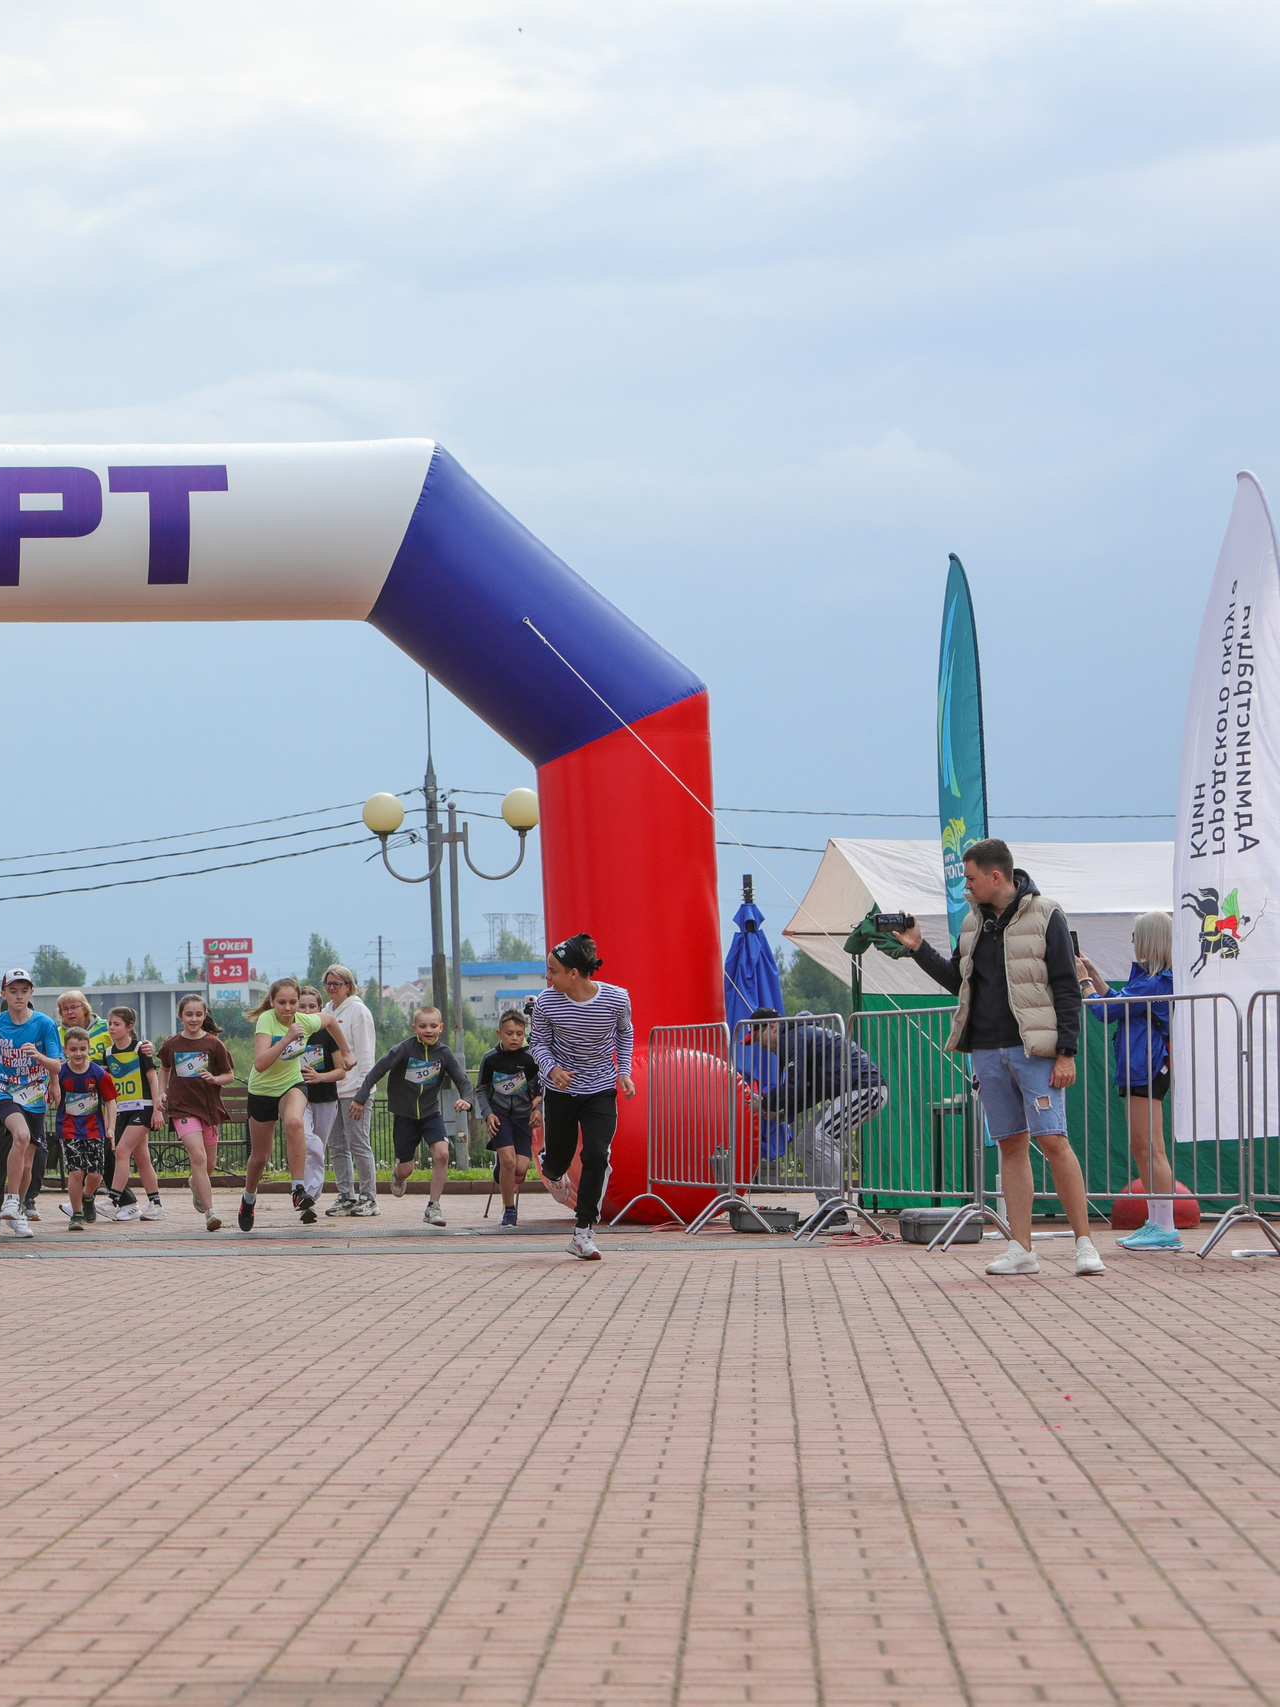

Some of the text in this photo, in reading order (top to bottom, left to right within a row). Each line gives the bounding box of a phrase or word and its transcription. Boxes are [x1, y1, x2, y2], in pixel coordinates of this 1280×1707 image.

[187, 1062, 194, 1070] 8
[416, 1069, 429, 1079] 30
[116, 1081, 136, 1096] 210
[503, 1081, 515, 1090] 29
[19, 1092, 28, 1100] 11
[78, 1102, 85, 1110] 9
